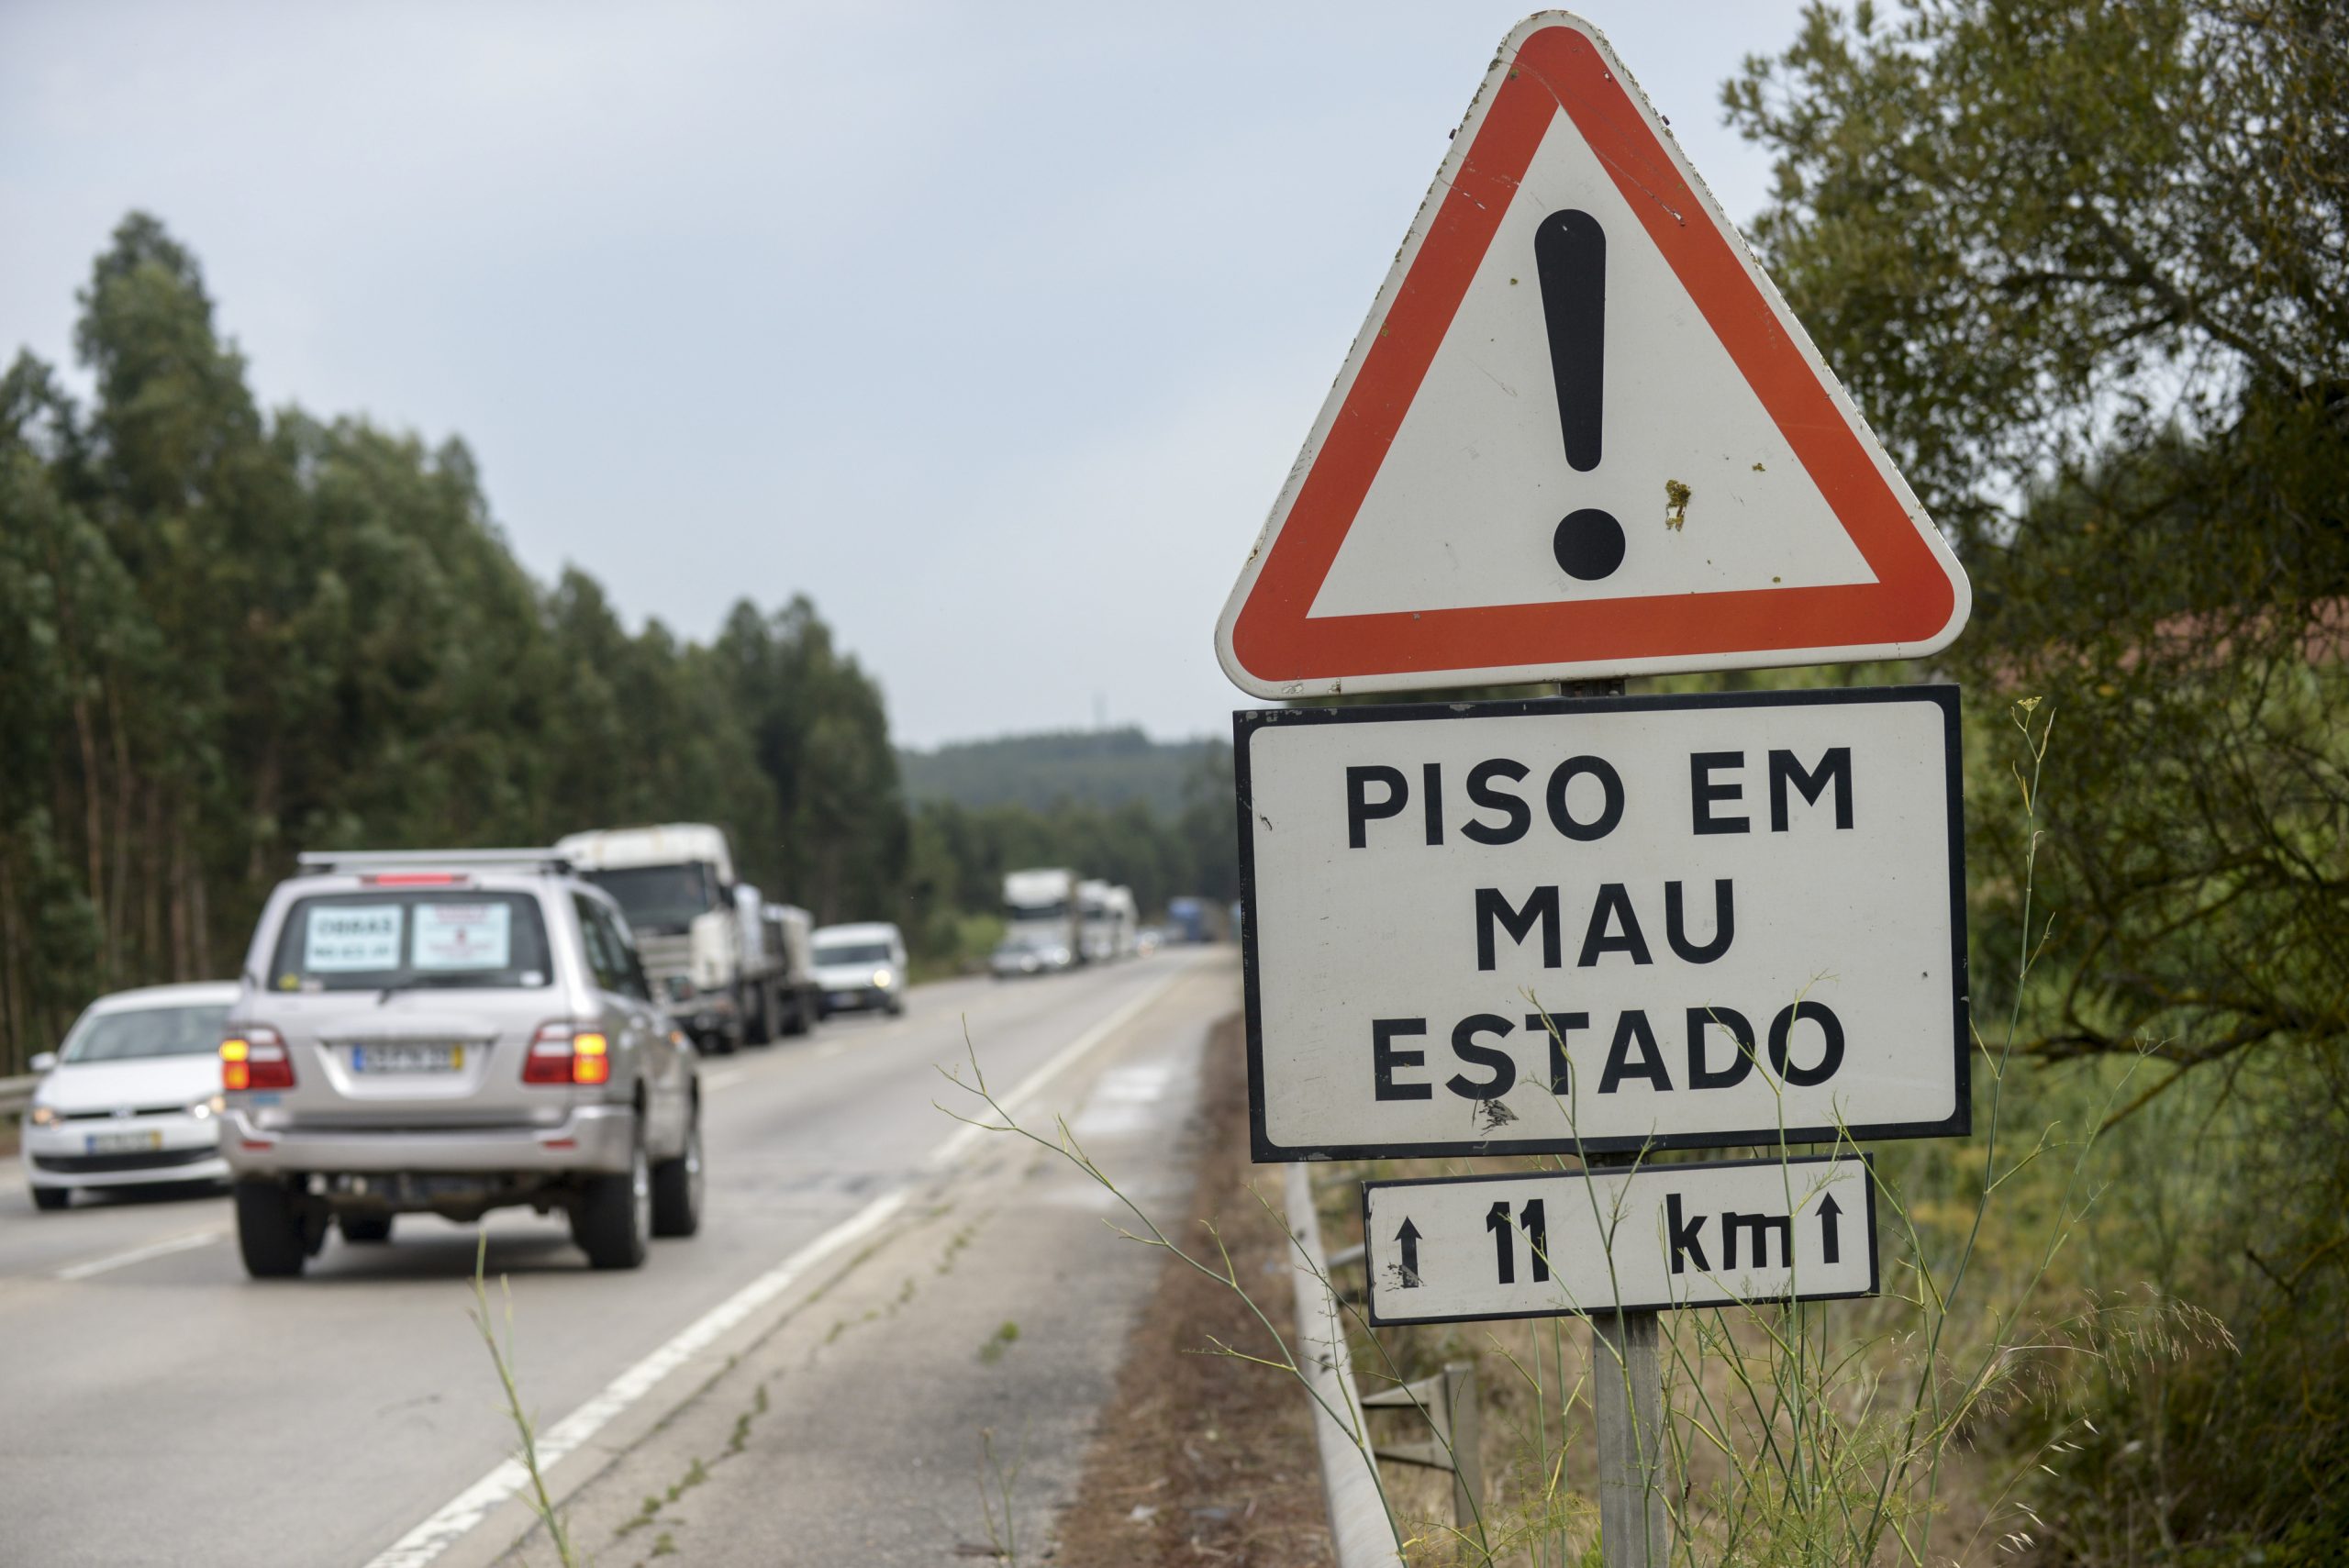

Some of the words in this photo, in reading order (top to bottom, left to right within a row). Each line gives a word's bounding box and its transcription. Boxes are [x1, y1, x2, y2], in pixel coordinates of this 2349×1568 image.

[1347, 755, 1624, 848] PISO
[1691, 748, 1853, 835] EM
[1475, 879, 1734, 971] MAU
[1373, 1000, 1845, 1102] ESTADO
[1486, 1198, 1550, 1284] 11
[1666, 1194, 1792, 1273] km
